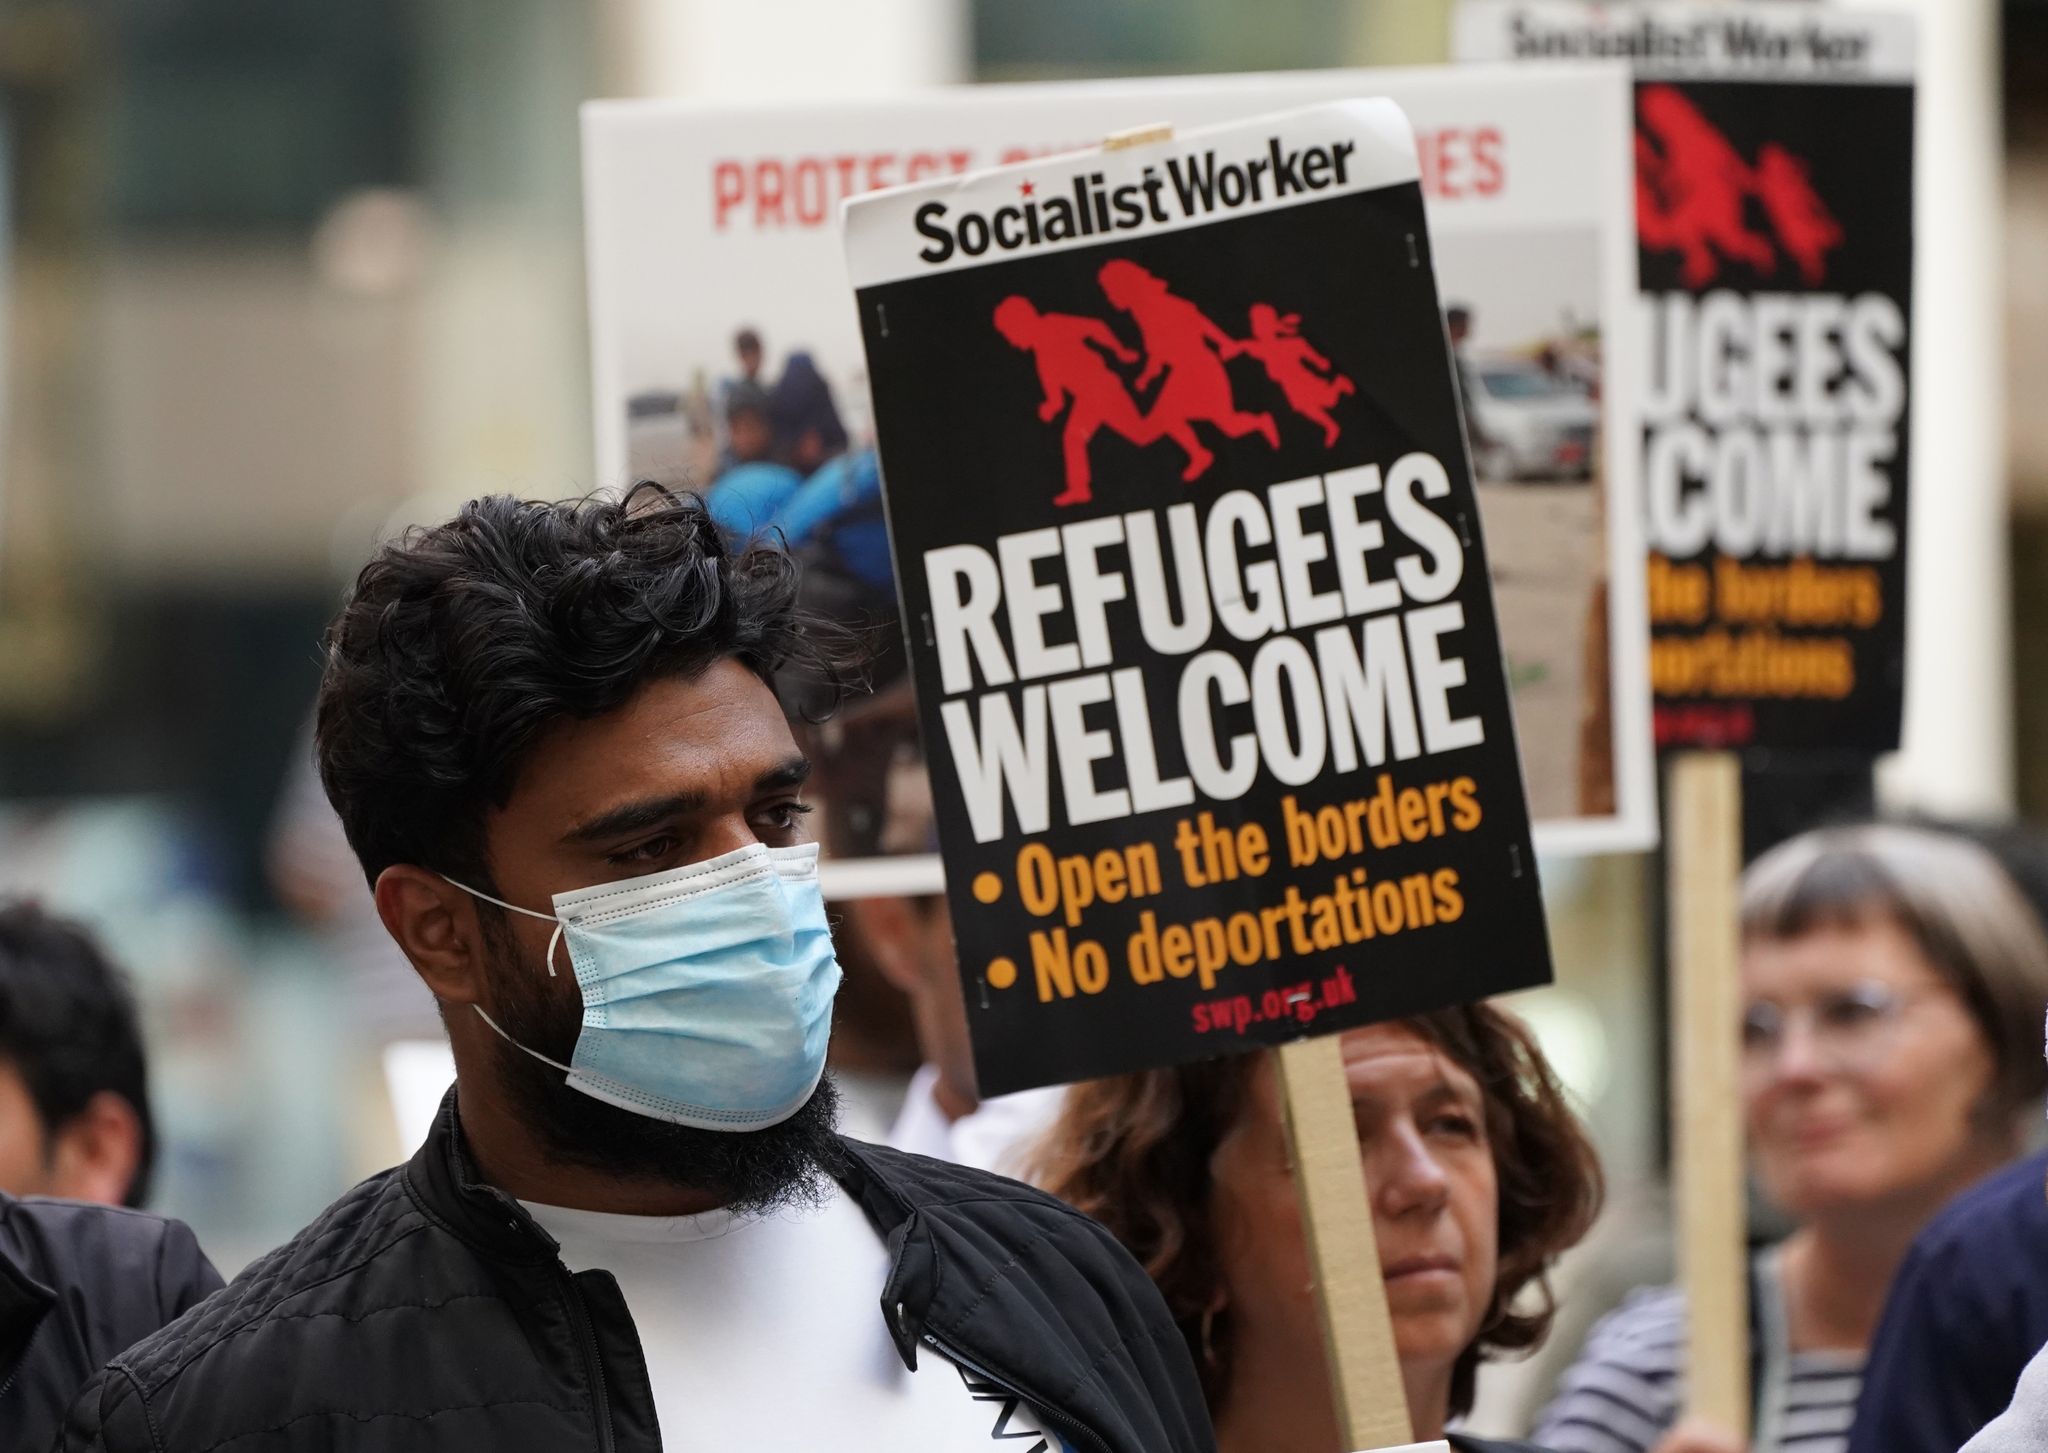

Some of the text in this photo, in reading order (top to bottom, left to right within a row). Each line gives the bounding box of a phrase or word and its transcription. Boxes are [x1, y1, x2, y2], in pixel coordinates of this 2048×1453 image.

[923, 452, 1464, 695] REFUGEES
[940, 601, 1485, 844] WELCOME
[1017, 773, 1483, 927] Open the borders
[1029, 868, 1464, 1003] No deportations
[1191, 965, 1357, 1035] swp.org.uk
